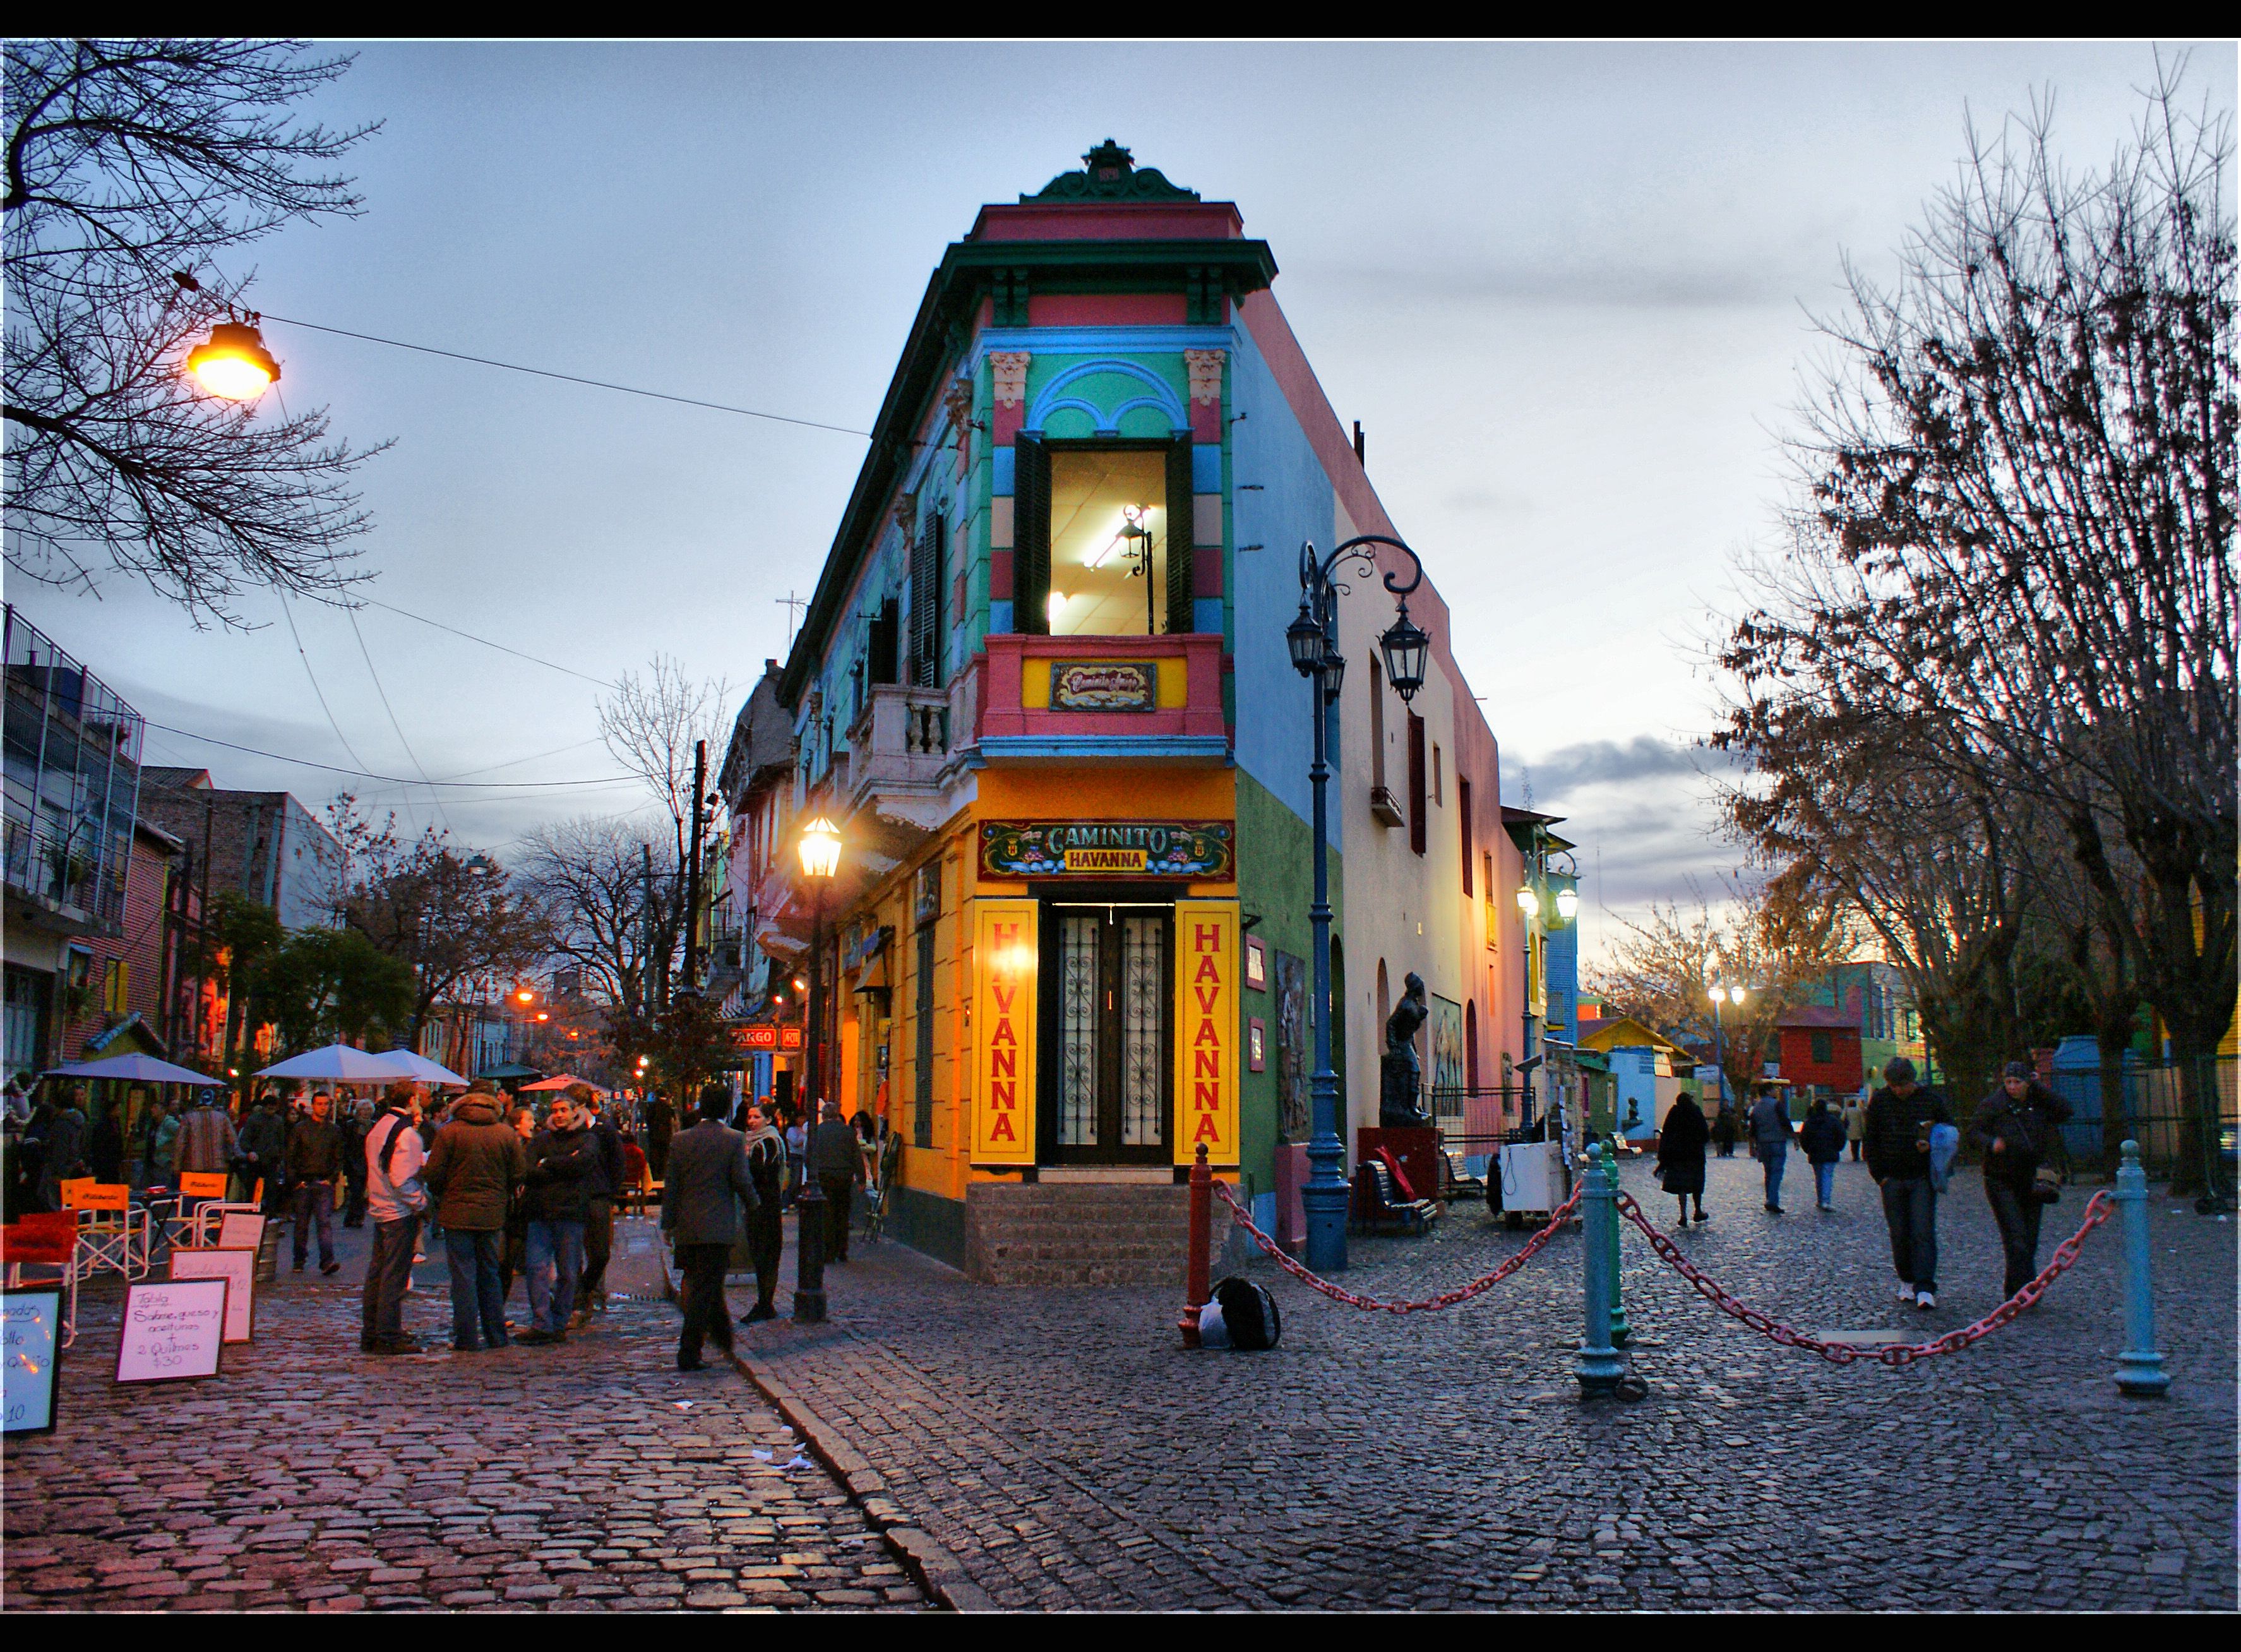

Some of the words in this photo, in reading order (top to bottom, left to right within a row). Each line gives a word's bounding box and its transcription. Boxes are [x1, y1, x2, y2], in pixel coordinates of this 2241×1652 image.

[1047, 827, 1167, 854] CAMINITO
[1070, 852, 1142, 868] HAVANNA
[1193, 924, 1221, 1142] HAVANNA
[137, 1292, 169, 1304] Tabla
[178, 1310, 210, 1321] queso
[148, 1322, 200, 1332] aceitunas
[138, 1344, 146, 1355] 2
[151, 1342, 200, 1356] Quilmes
[153, 1355, 182, 1368] $30
